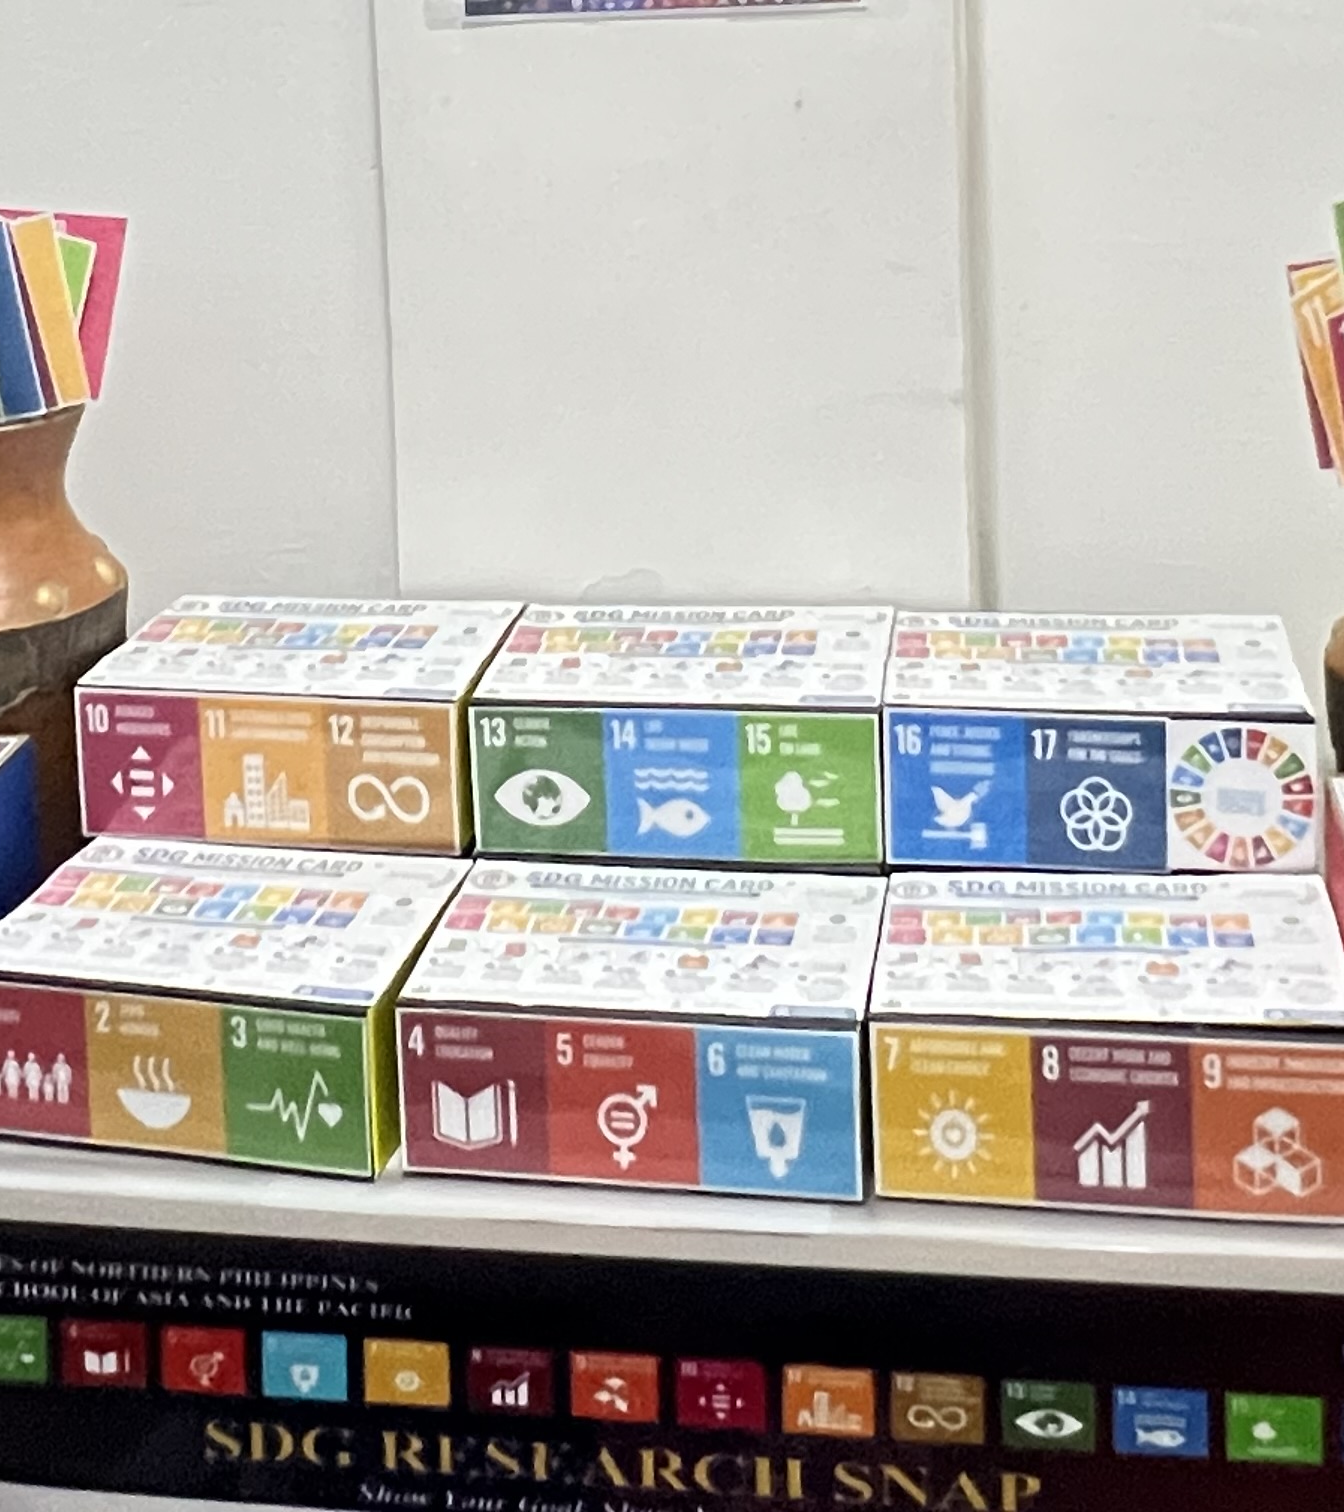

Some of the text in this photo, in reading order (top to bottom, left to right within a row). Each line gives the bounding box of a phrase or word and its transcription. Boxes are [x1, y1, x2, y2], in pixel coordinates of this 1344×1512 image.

[85, 702, 109, 732] 10
[205, 708, 225, 739] 11
[328, 714, 355, 745] 12
[480, 717, 506, 747] 13
[610, 719, 637, 751] 14
[745, 722, 772, 755] 15
[894, 723, 922, 756] 16
[1031, 728, 1057, 760] 17
[135, 846, 189, 864] SDG
[191, 851, 294, 870] MISSION
[526, 870, 583, 886] SDG
[590, 874, 697, 889] MISSION
[948, 879, 1006, 894] SDG
[1015, 880, 1127, 896] MISSION
[94, 1000, 111, 1033] 2
[231, 1016, 247, 1049] 3
[408, 1024, 425, 1056] 4
[556, 1032, 574, 1066] 5
[884, 1036, 899, 1073] 7
[707, 1042, 726, 1077] 6
[1042, 1044, 1060, 1080] 8
[1202, 1052, 1222, 1090] 9
[204, 1419, 1042, 1512] SDG RESEARCH SNAP
